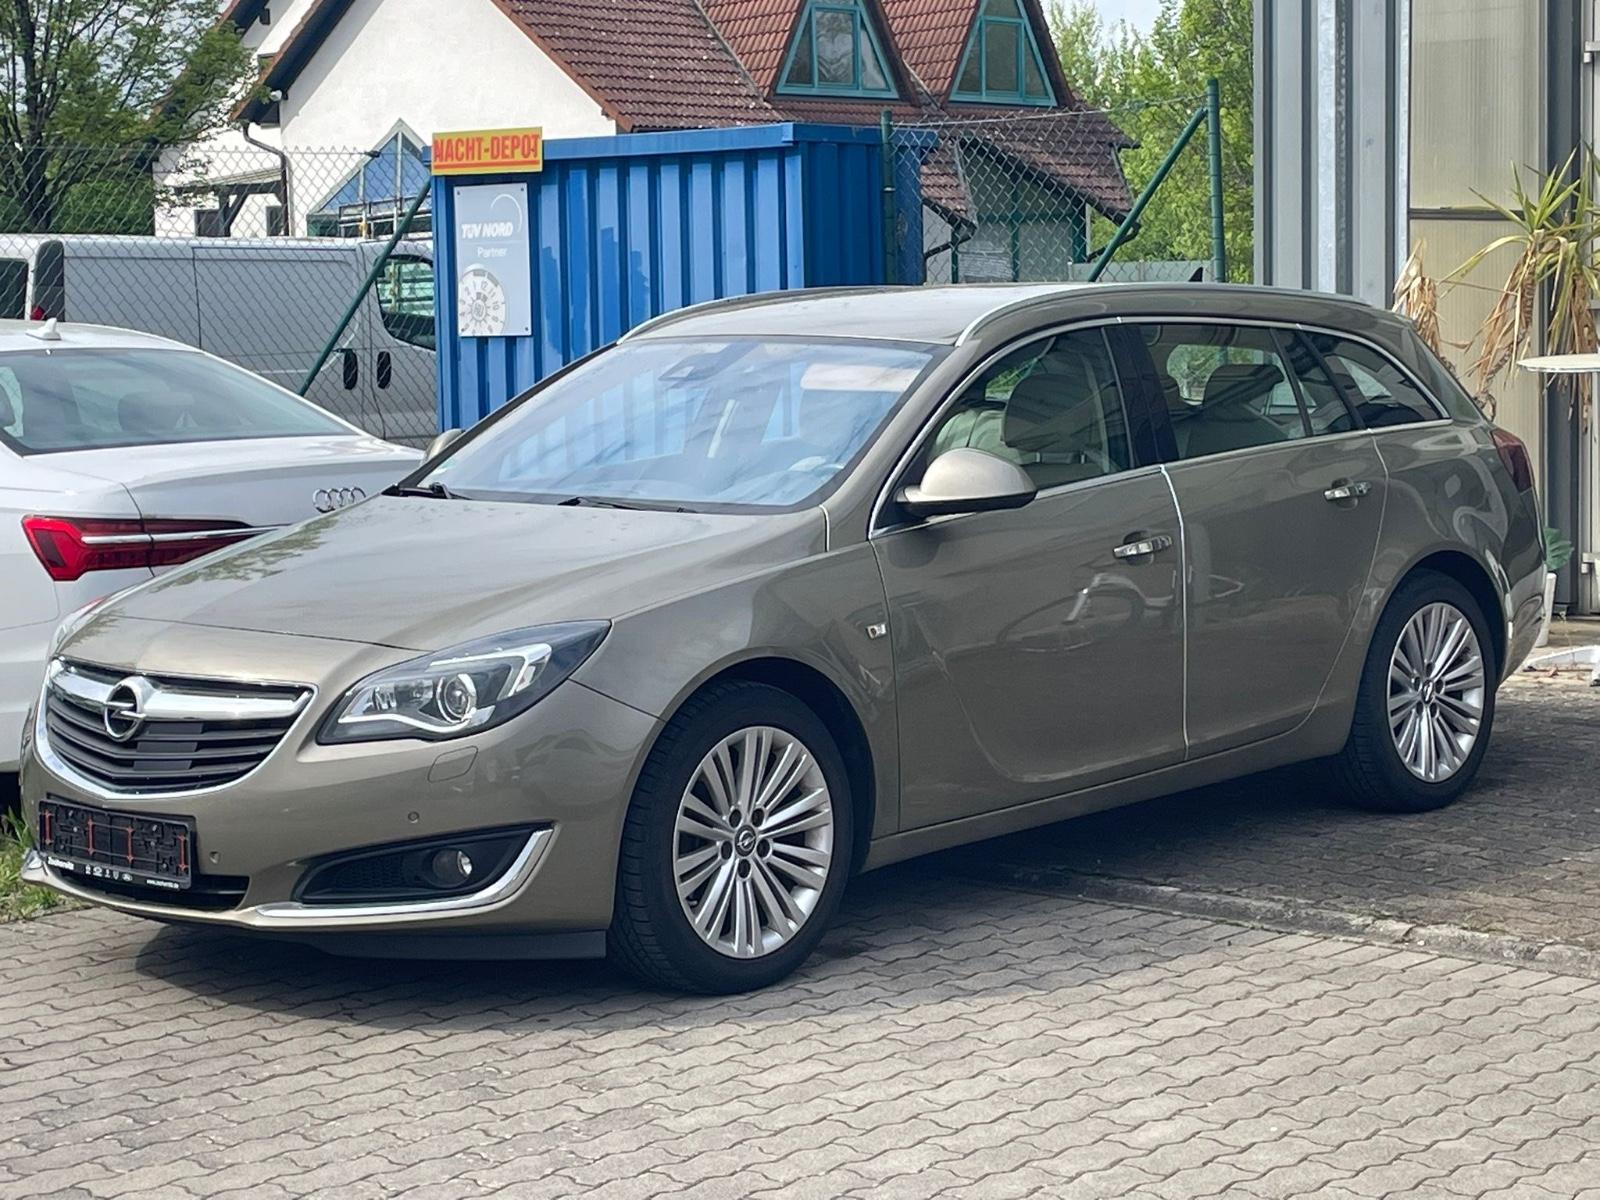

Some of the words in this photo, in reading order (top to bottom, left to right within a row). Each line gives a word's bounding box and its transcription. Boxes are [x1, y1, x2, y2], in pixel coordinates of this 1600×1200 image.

[433, 134, 540, 162] NACHT-DEPOT
[461, 223, 482, 239] TÜV
[482, 222, 513, 238] NORD
[477, 246, 508, 258] Partner
